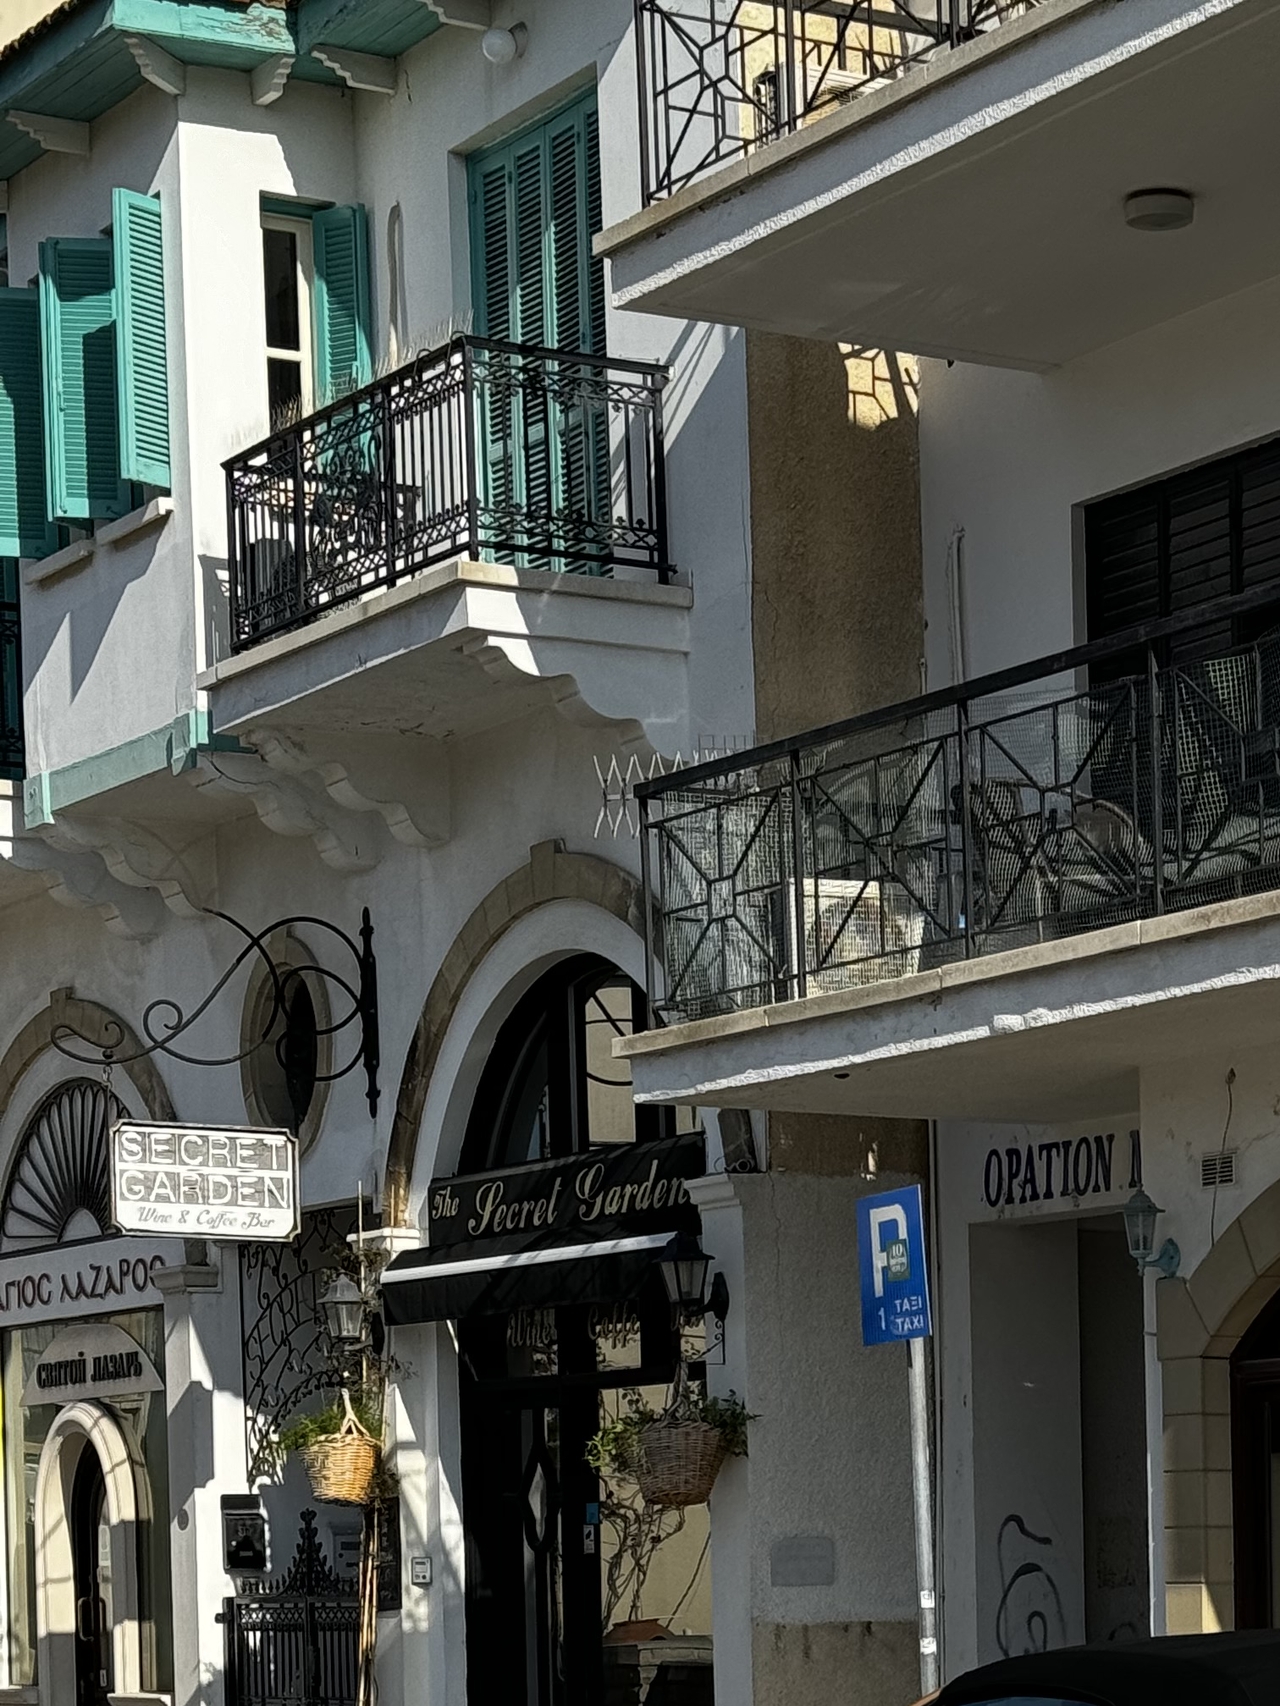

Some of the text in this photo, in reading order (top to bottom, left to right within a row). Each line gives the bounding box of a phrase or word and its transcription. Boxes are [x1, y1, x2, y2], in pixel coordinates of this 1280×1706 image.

[121, 1131, 286, 1169] SECRET
[121, 1170, 287, 1208] GARDEN
[432, 1159, 688, 1236] The Secret Garden
[138, 1206, 276, 1229] Wine & Coffee Bar
[895, 1314, 924, 1332] TAXI
[37, 1351, 142, 1388] СВЯТОЙ ЛАЗАРЬ
